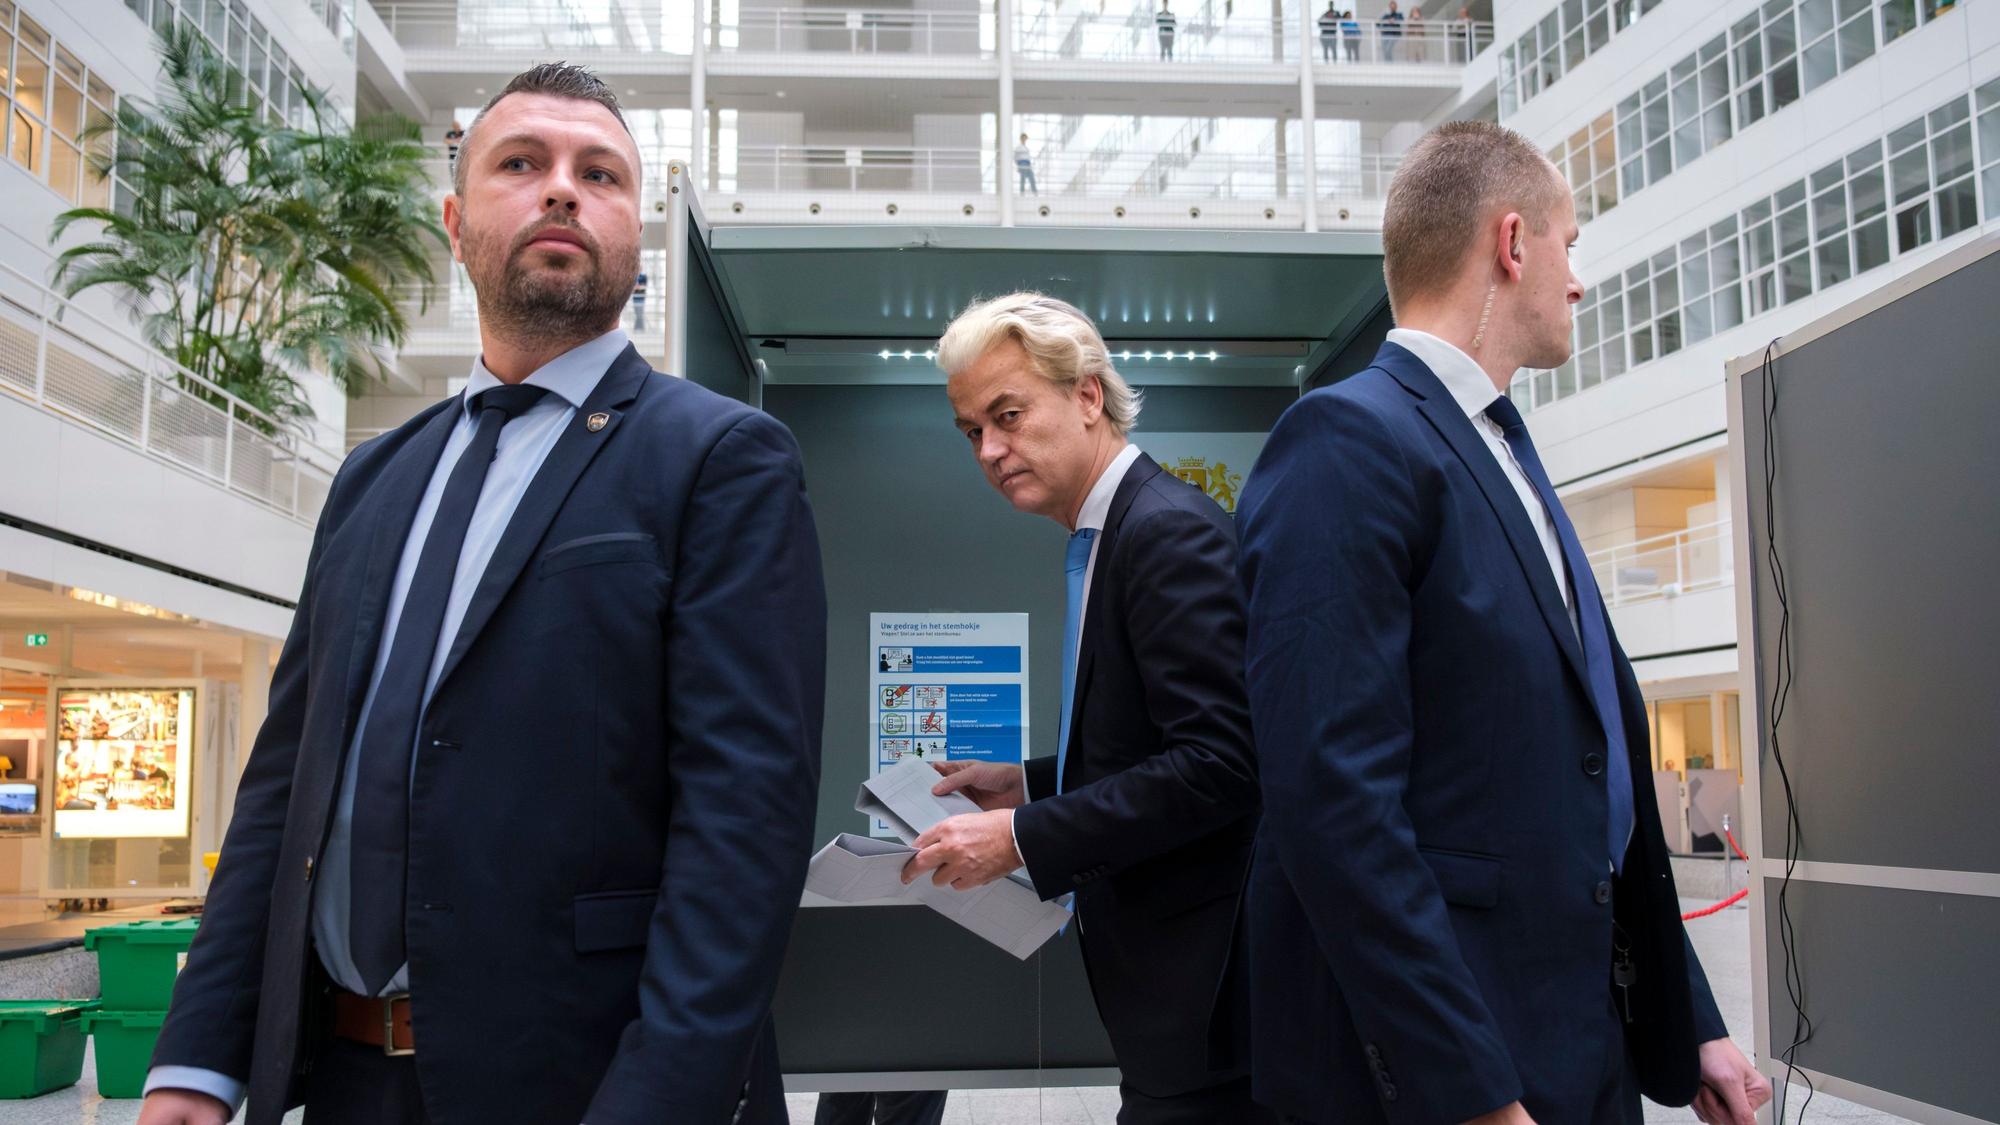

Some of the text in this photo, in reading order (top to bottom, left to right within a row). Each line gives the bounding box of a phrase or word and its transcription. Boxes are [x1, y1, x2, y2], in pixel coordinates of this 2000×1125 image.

[881, 622, 980, 631] Uw gedrag in het stemhokje
